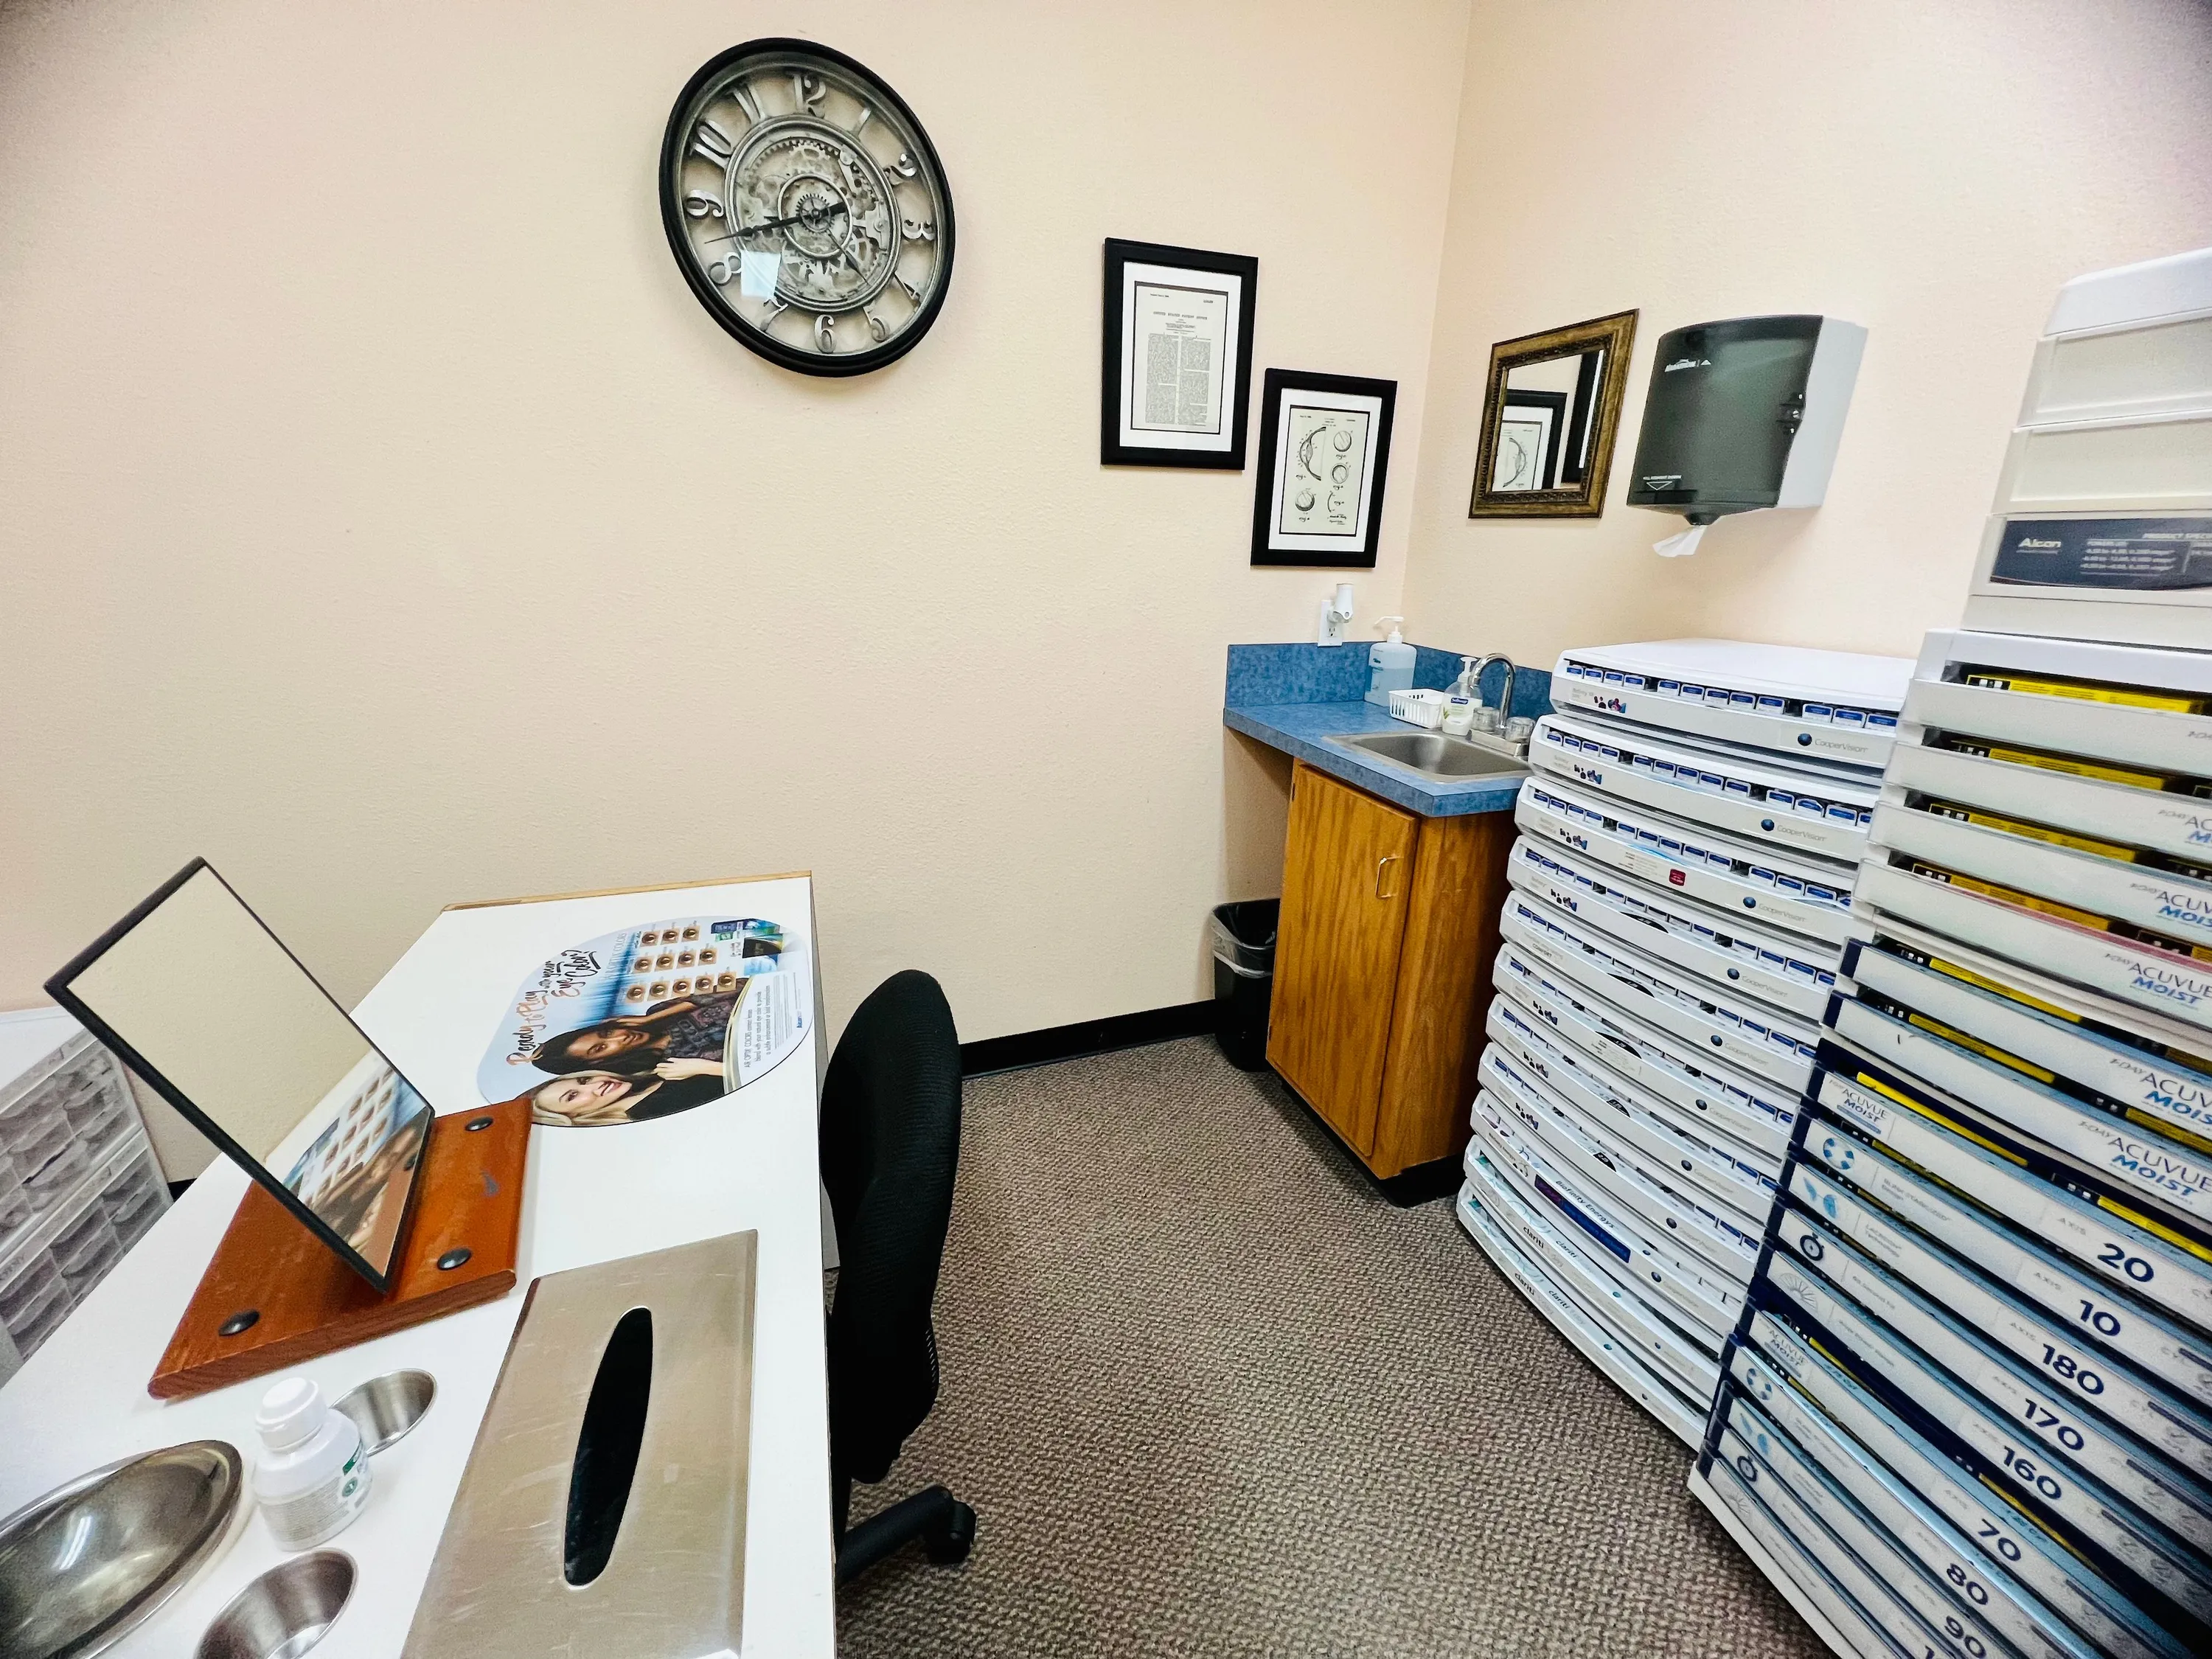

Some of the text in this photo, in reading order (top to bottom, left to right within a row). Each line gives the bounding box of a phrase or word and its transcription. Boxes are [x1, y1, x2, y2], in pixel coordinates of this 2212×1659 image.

[792, 74, 826, 119] 12
[855, 108, 871, 137] 1
[690, 119, 733, 169] 10
[885, 153, 917, 187] 2
[686, 189, 725, 219] 9
[902, 218, 936, 240] 3
[707, 251, 742, 285] 8
[894, 272, 921, 312] 4
[814, 314, 837, 354] 6
[863, 305, 890, 343] 5
[2019, 538, 2062, 549] Alcon
[551, 978, 586, 998] Eye
[2129, 962, 2212, 998] ACUVUE
[2132, 975, 2202, 1005] MOIST
[1843, 1088, 1891, 1120] ACUVUE
[1843, 1098, 1882, 1122] MOIST
[2109, 1137, 2212, 1192] ACUVUE
[2112, 1154, 2198, 1197] MOIST
[1556, 1180, 1585, 1204] Biofinity
[1586, 1204, 1615, 1228] Energys
[1523, 1226, 1544, 1248] clariti
[1556, 1239, 1577, 1258] clariti
[2097, 1242, 2154, 1282] 20
[1514, 1273, 1535, 1295] clariti
[1548, 1290, 1570, 1309] clariti
[2080, 1299, 2121, 1336] 10
[1770, 1339, 1801, 1366] MOIST
[2043, 1343, 2104, 1395] 180
[2025, 1398, 2084, 1450] 170
[2004, 1445, 2062, 1500] 160
[1978, 1518, 2021, 1562] 70
[1947, 1563, 1989, 1605] 80
[1944, 1615, 1986, 1659] 90
